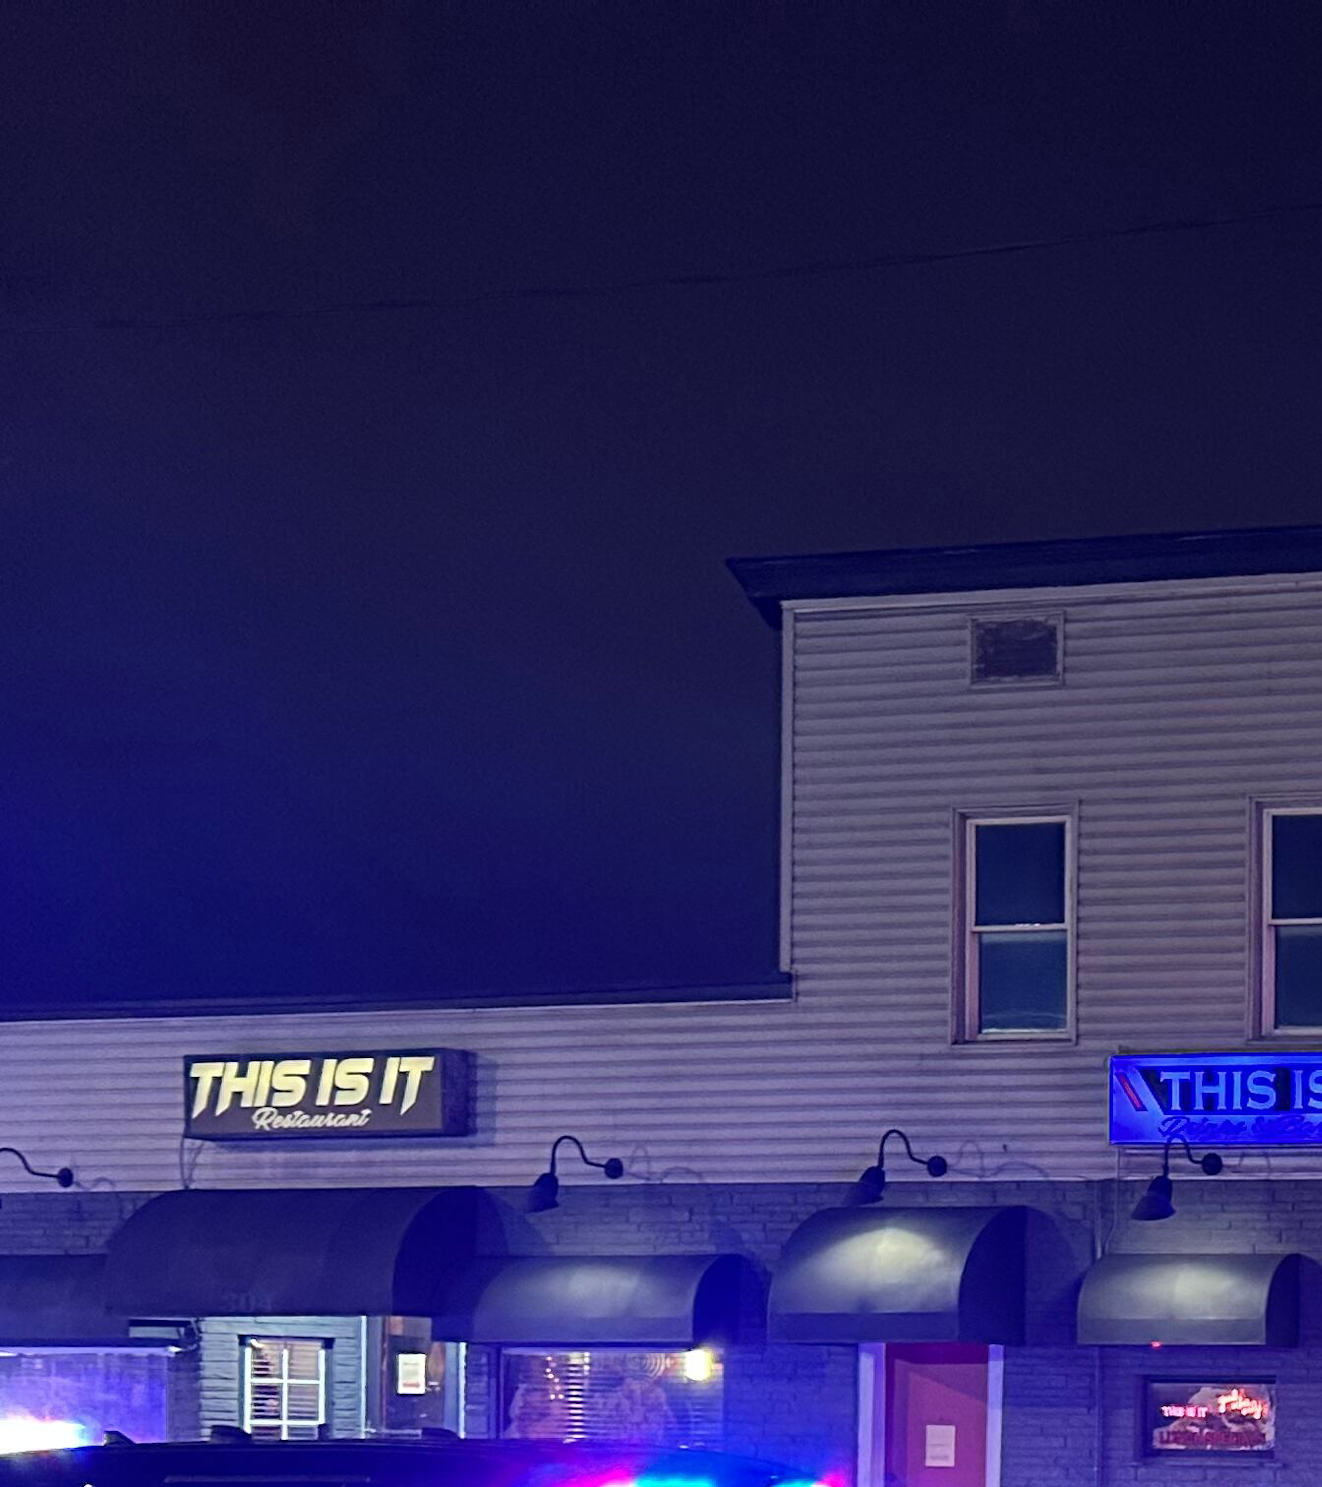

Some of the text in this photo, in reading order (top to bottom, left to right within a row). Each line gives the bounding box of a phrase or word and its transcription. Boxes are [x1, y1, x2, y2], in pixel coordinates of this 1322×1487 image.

[190, 1057, 435, 1119] THIS IS IT
[1160, 1070, 1277, 1110] THIS
[252, 1107, 372, 1130] Restaurant
